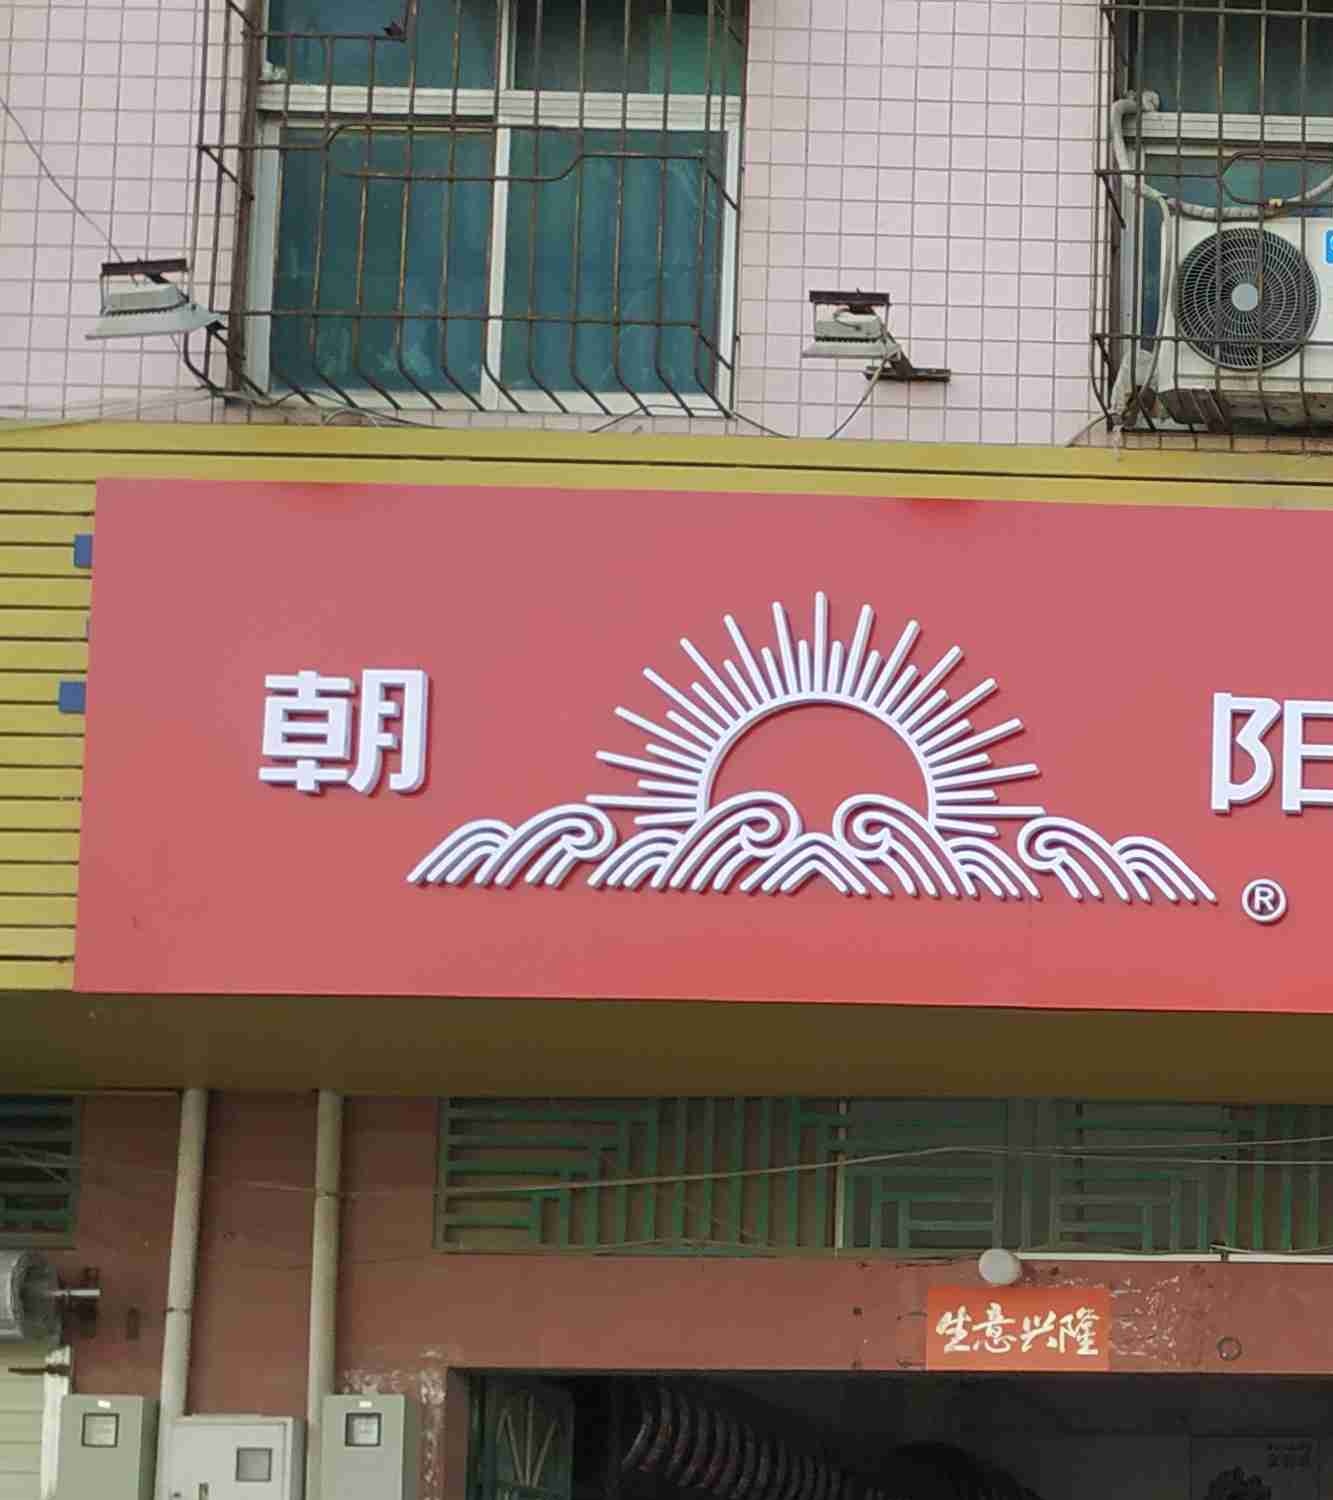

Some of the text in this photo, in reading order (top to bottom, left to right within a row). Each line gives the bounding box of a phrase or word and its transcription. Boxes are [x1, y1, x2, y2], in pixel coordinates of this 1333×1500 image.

[258, 668, 429, 793] 朝
[935, 1301, 1100, 1355] 生意兴隆
